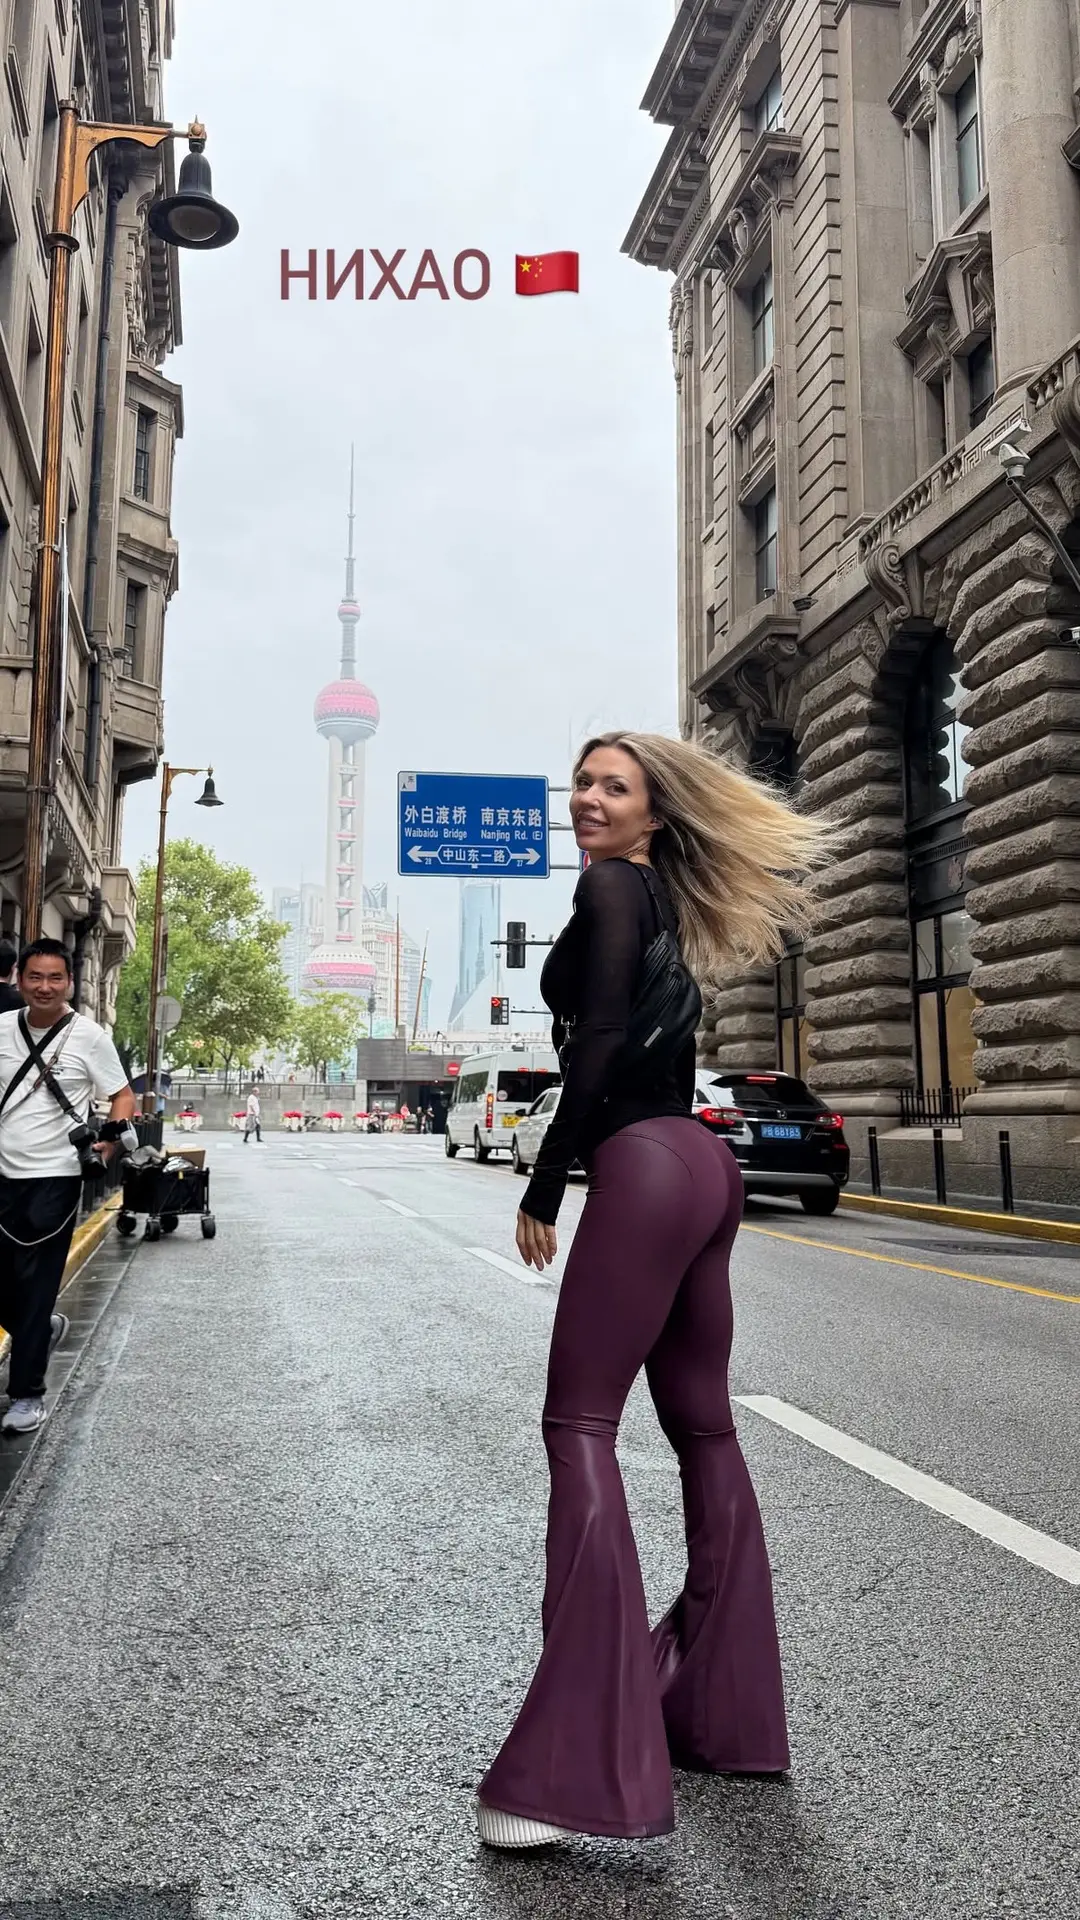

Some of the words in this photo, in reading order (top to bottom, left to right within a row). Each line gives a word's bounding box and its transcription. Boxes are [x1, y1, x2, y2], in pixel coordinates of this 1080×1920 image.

[404, 805, 467, 825] 外白渡桥
[481, 807, 542, 827] 南京东路
[404, 827, 438, 838] Waibaidu
[443, 828, 467, 841] Bridge
[481, 829, 511, 842] Nanjing
[514, 830, 528, 840] Rd.
[443, 848, 505, 863] 中山东一路
